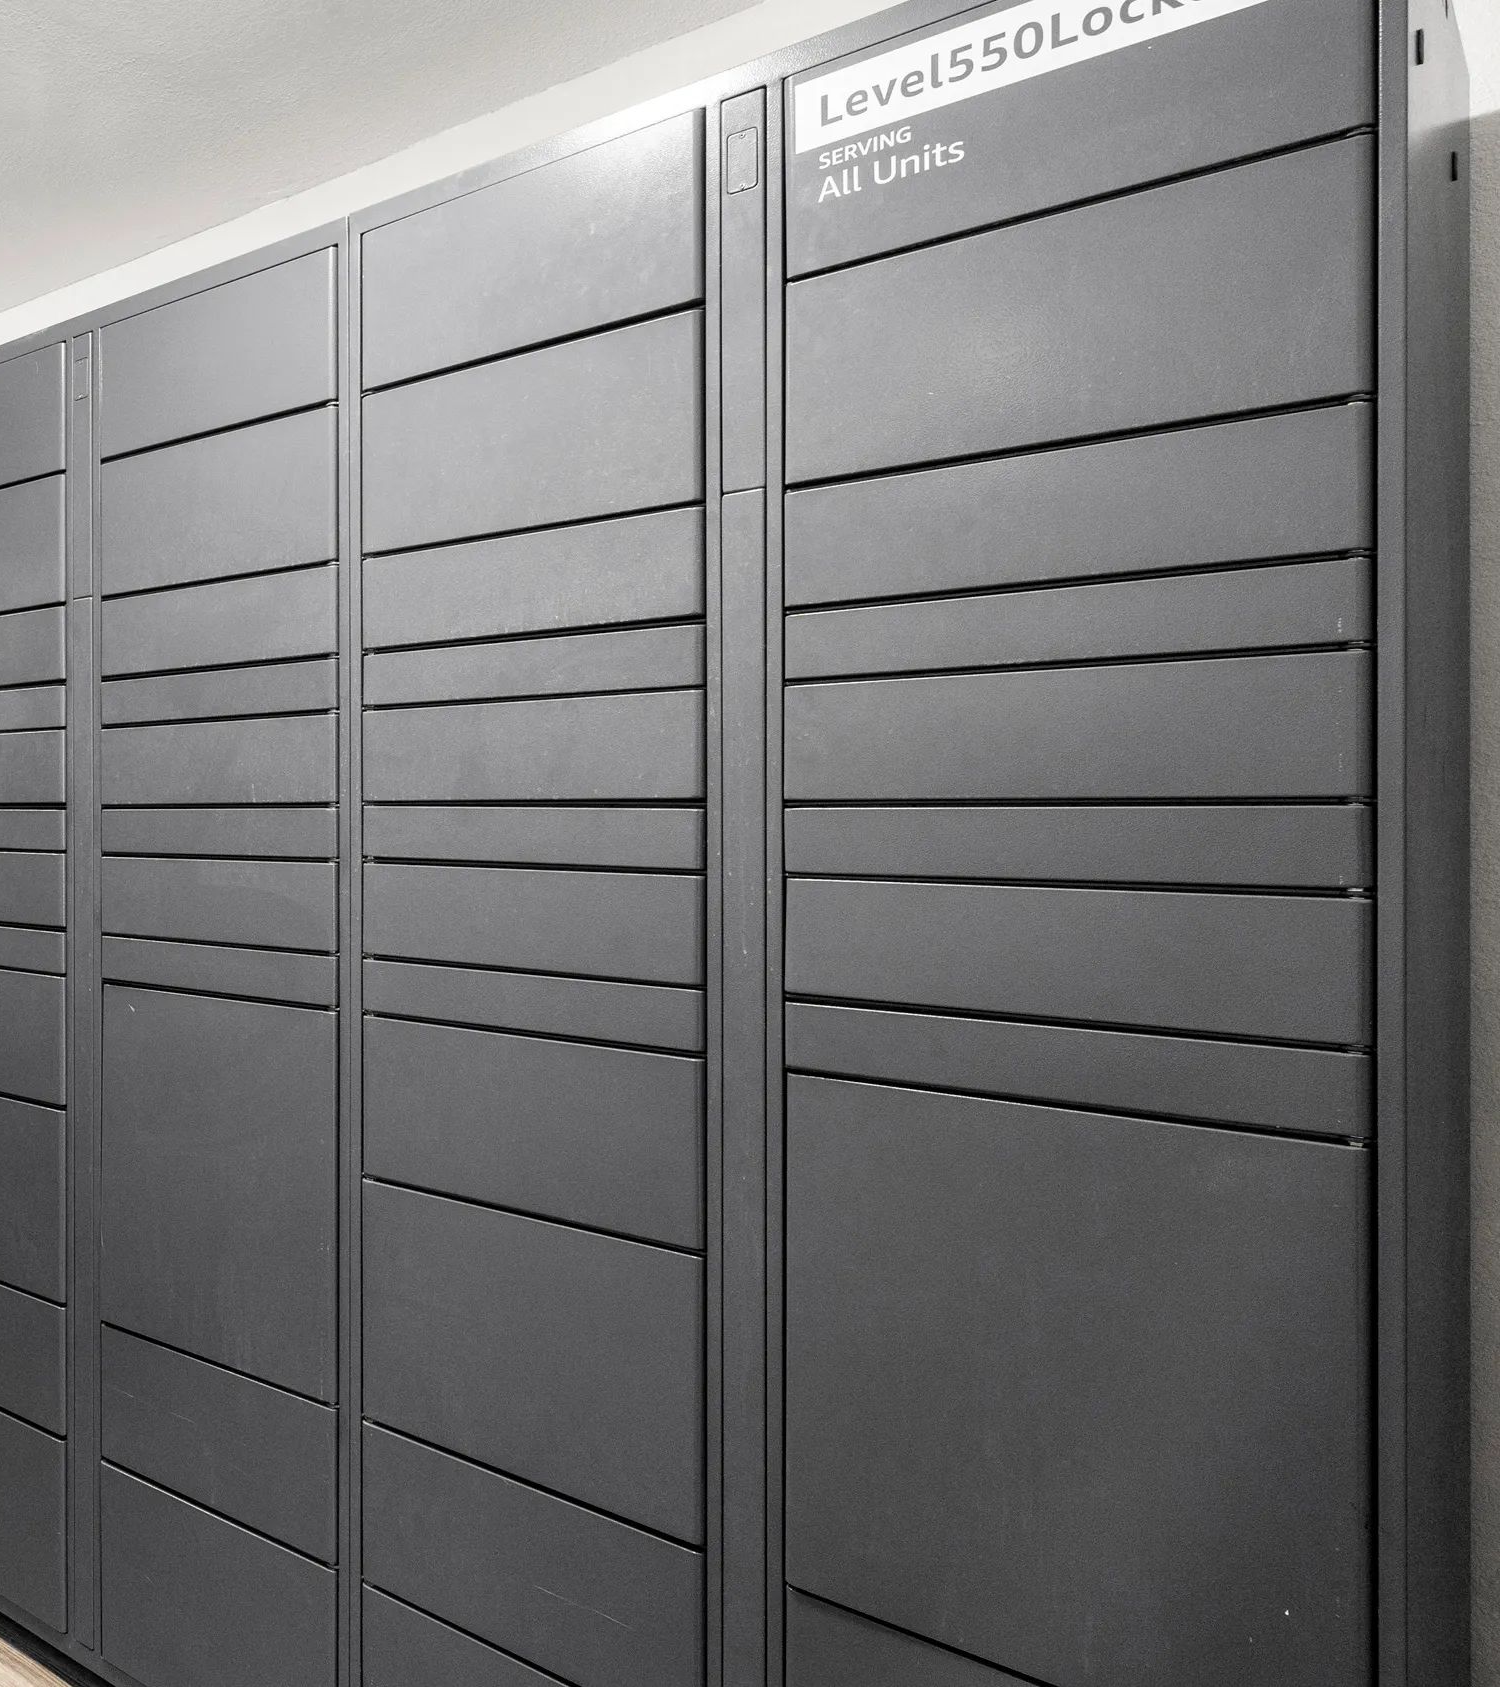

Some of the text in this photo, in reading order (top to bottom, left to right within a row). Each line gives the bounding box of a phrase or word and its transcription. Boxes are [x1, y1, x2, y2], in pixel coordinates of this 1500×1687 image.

[818, 126, 912, 170] SERVING
[818, 140, 965, 203] All Units
